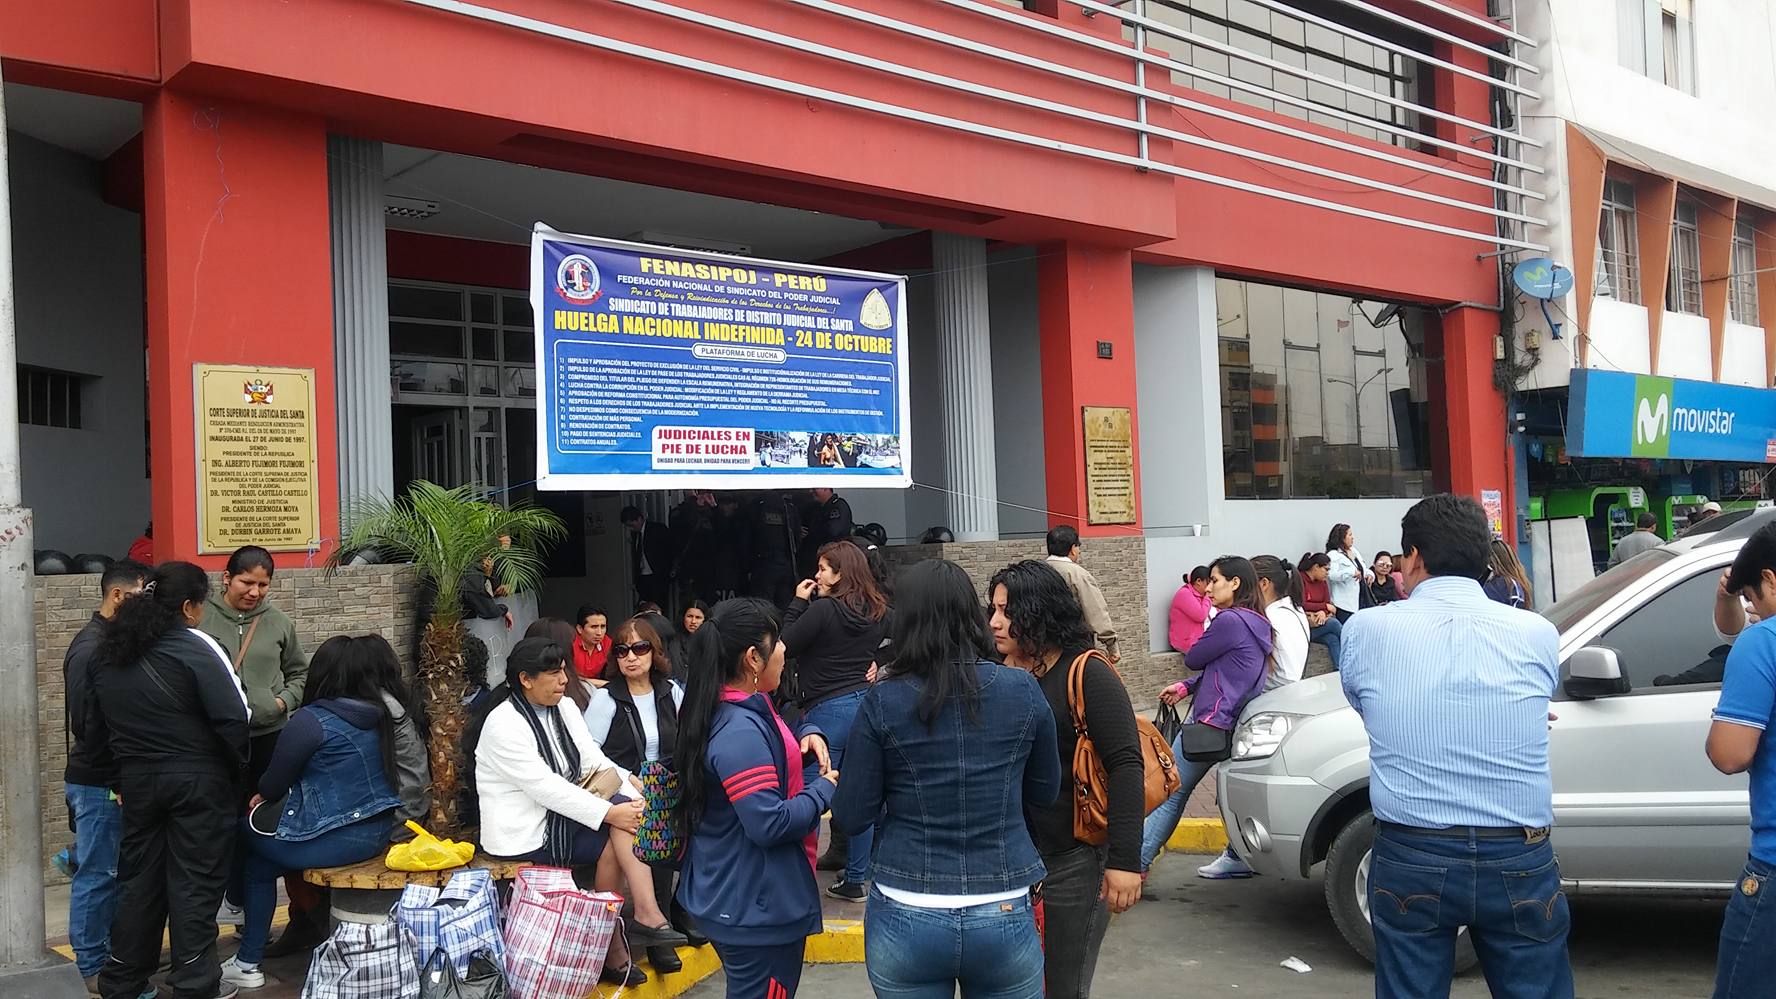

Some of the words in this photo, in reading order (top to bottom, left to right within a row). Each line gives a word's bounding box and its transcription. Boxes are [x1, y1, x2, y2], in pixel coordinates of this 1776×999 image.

[640, 257, 757, 284] FENASIPOJ
[774, 273, 827, 292] PERÚ
[618, 275, 670, 288] FEDERACIÓN
[672, 281, 712, 292] NACIONAL
[726, 286, 767, 297] SINDICATO
[768, 290, 782, 299] DEL
[784, 292, 808, 302] PODER
[810, 295, 840, 305] JUDICIAL
[630, 287, 642, 296] Por
[654, 289, 678, 300] Defensa
[750, 299, 774, 308] Derechos
[609, 298, 656, 315] SINDICATO
[659, 303, 669, 316] DE
[671, 304, 733, 321] TRABAJADORES
[735, 308, 745, 322] DE
[746, 309, 782, 325] DISTRITO
[783, 313, 816, 328] JUDICIAL
[817, 316, 830, 330] DEL
[831, 318, 853, 332] SANTA
[554, 310, 620, 334] HUELGA
[622, 316, 701, 340] NACIONAL
[704, 322, 784, 346] INDEFINIDA
[796, 330, 812, 348] 24
[816, 331, 832, 350] DE
[835, 333, 893, 354] OCTUBRE
[702, 348, 744, 356] PLATAFORMA
[757, 351, 778, 359] LUCHA
[209, 408, 225, 418] CORTE
[226, 408, 250, 418] SUPERIOR
[252, 409, 257, 418] DE
[258, 409, 279, 419] JUSTICIA
[280, 410, 289, 419] DEL
[290, 410, 305, 419] SANTA
[1672, 407, 1735, 434] movistar
[657, 428, 733, 441] JUDICIALES
[736, 430, 750, 442] EN
[662, 443, 683, 454] PIE
[686, 444, 702, 454] DE
[705, 444, 746, 455] LUCHA
